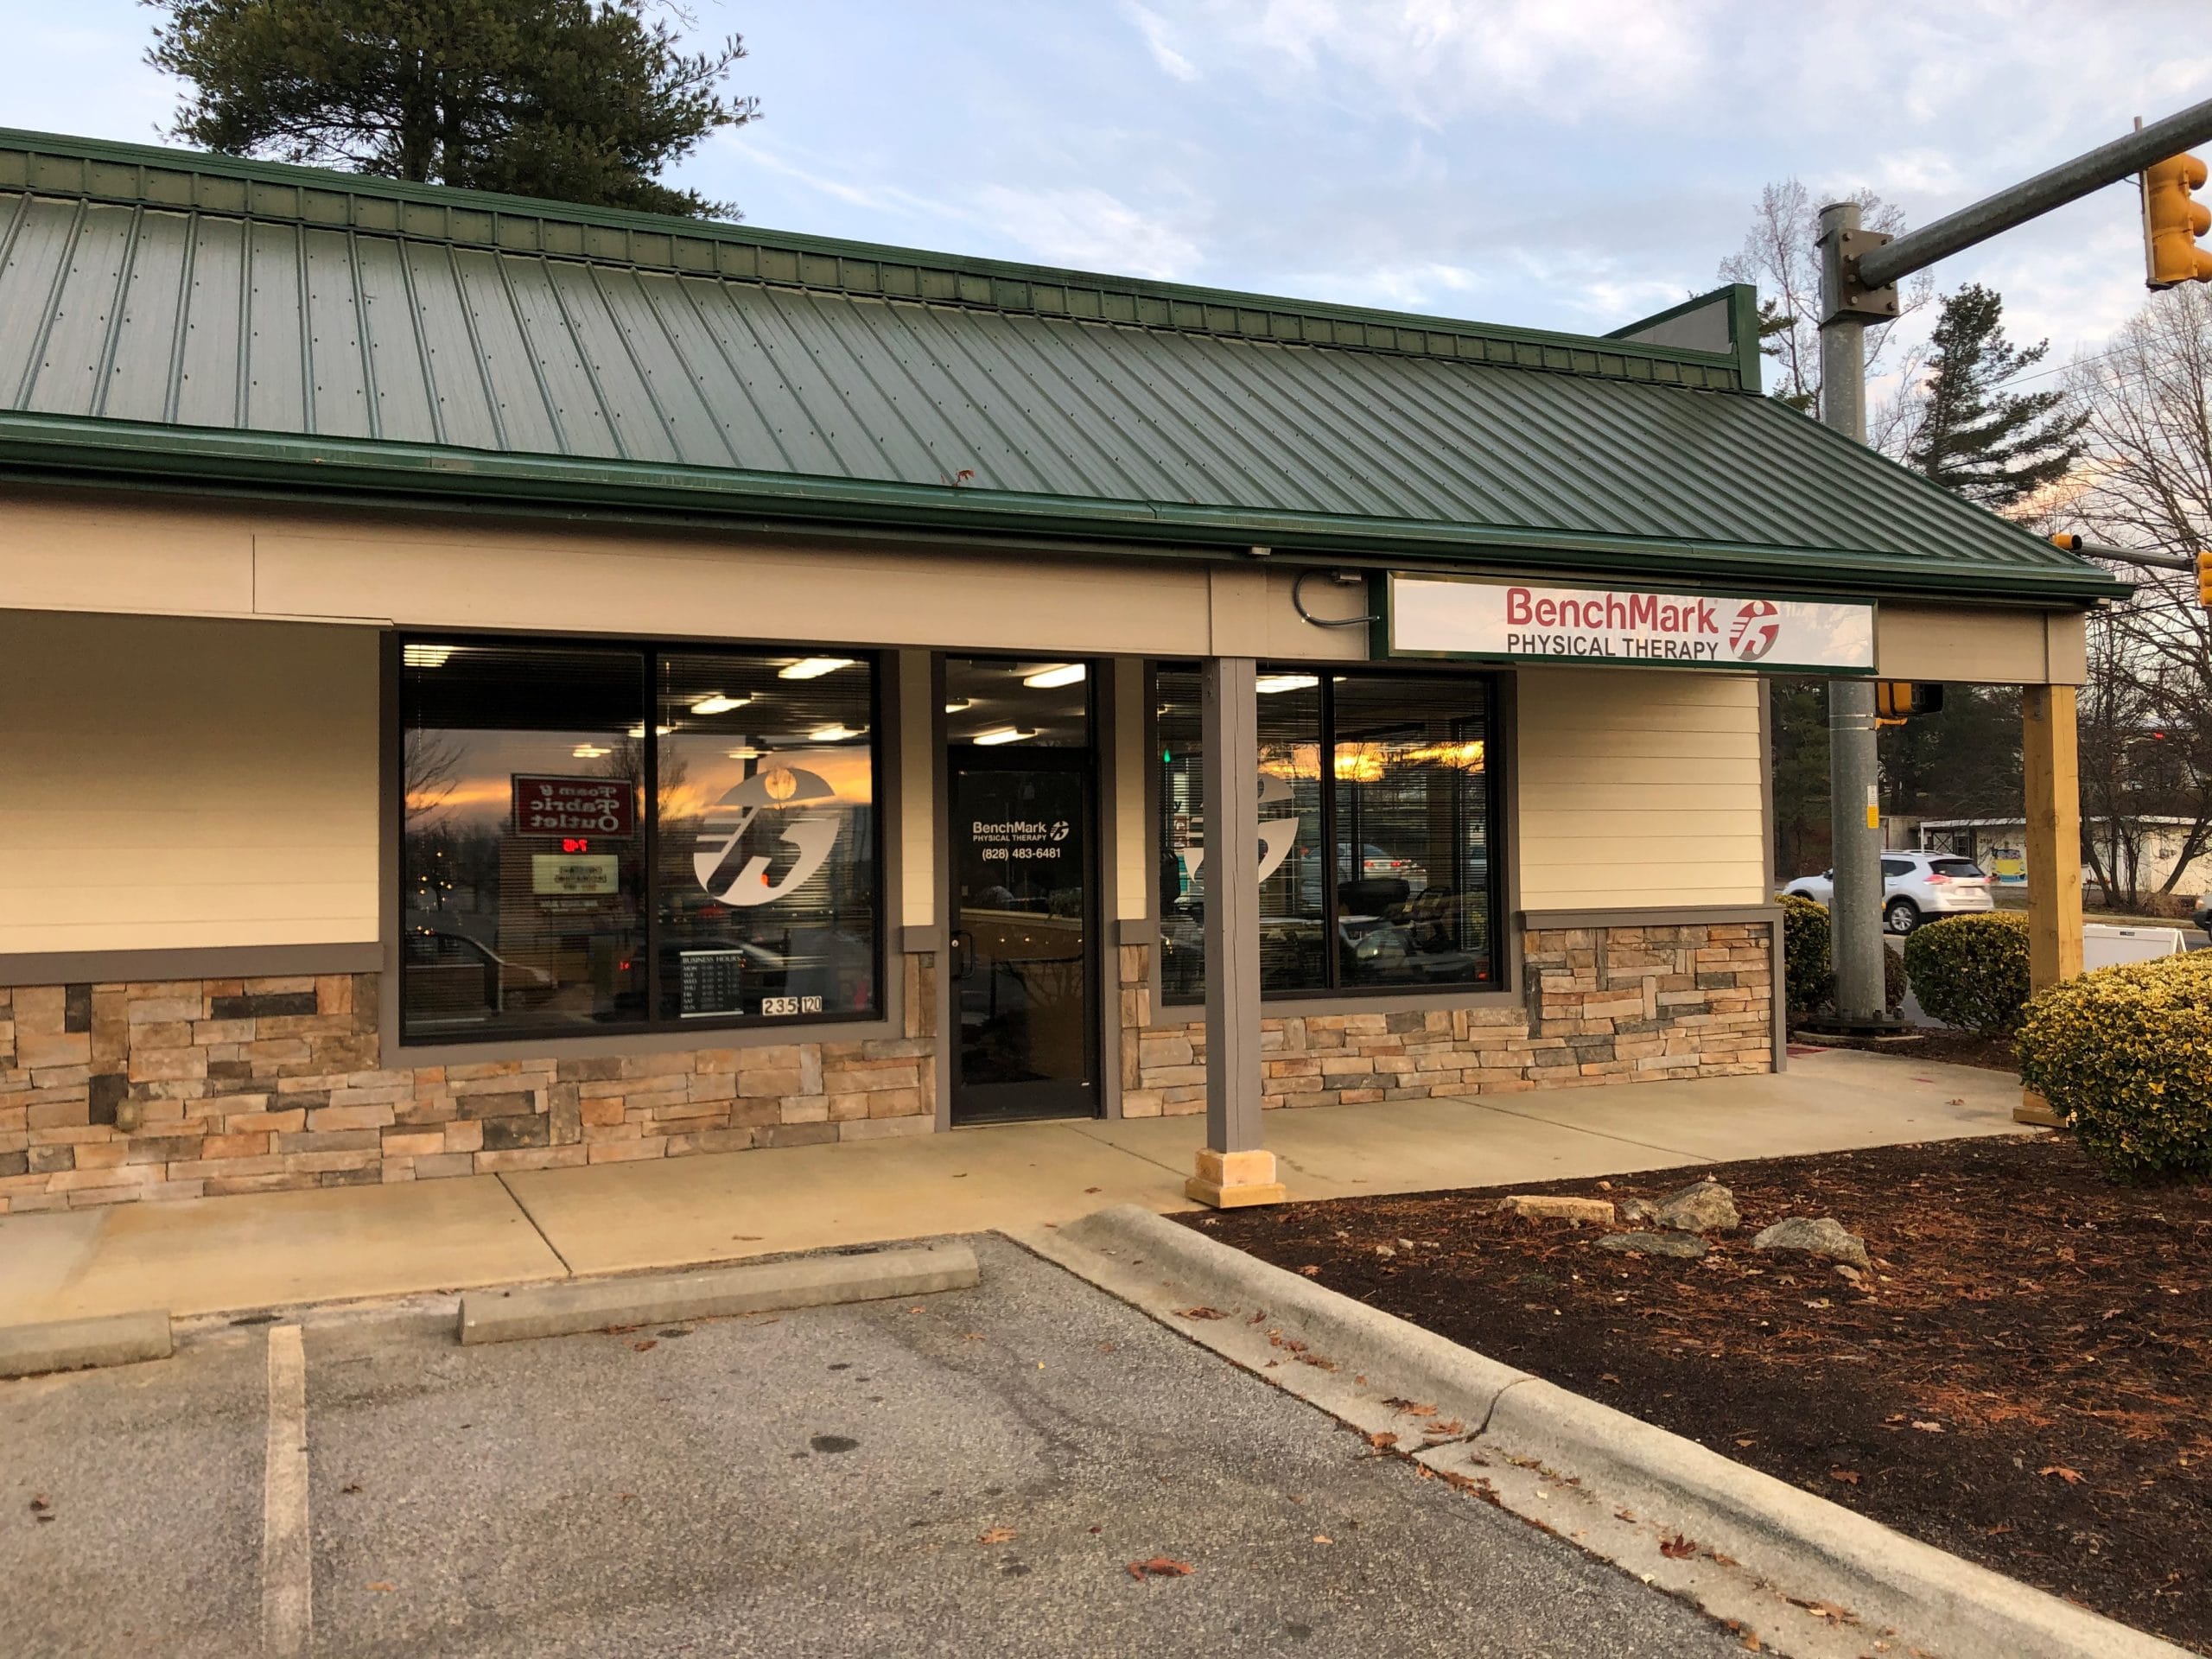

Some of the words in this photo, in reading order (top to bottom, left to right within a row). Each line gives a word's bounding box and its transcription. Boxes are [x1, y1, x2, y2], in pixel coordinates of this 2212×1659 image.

[1506, 588, 1719, 634] BenchMark
[1507, 633, 1616, 657] PHYSICAL
[1622, 637, 1719, 660] THERAPY
[972, 821, 1047, 834] BenchMark
[982, 848, 1009, 861] (828)
[1012, 848, 1061, 858] 483-6481
[764, 998, 797, 1014] 235
[804, 996, 821, 1012] 120
